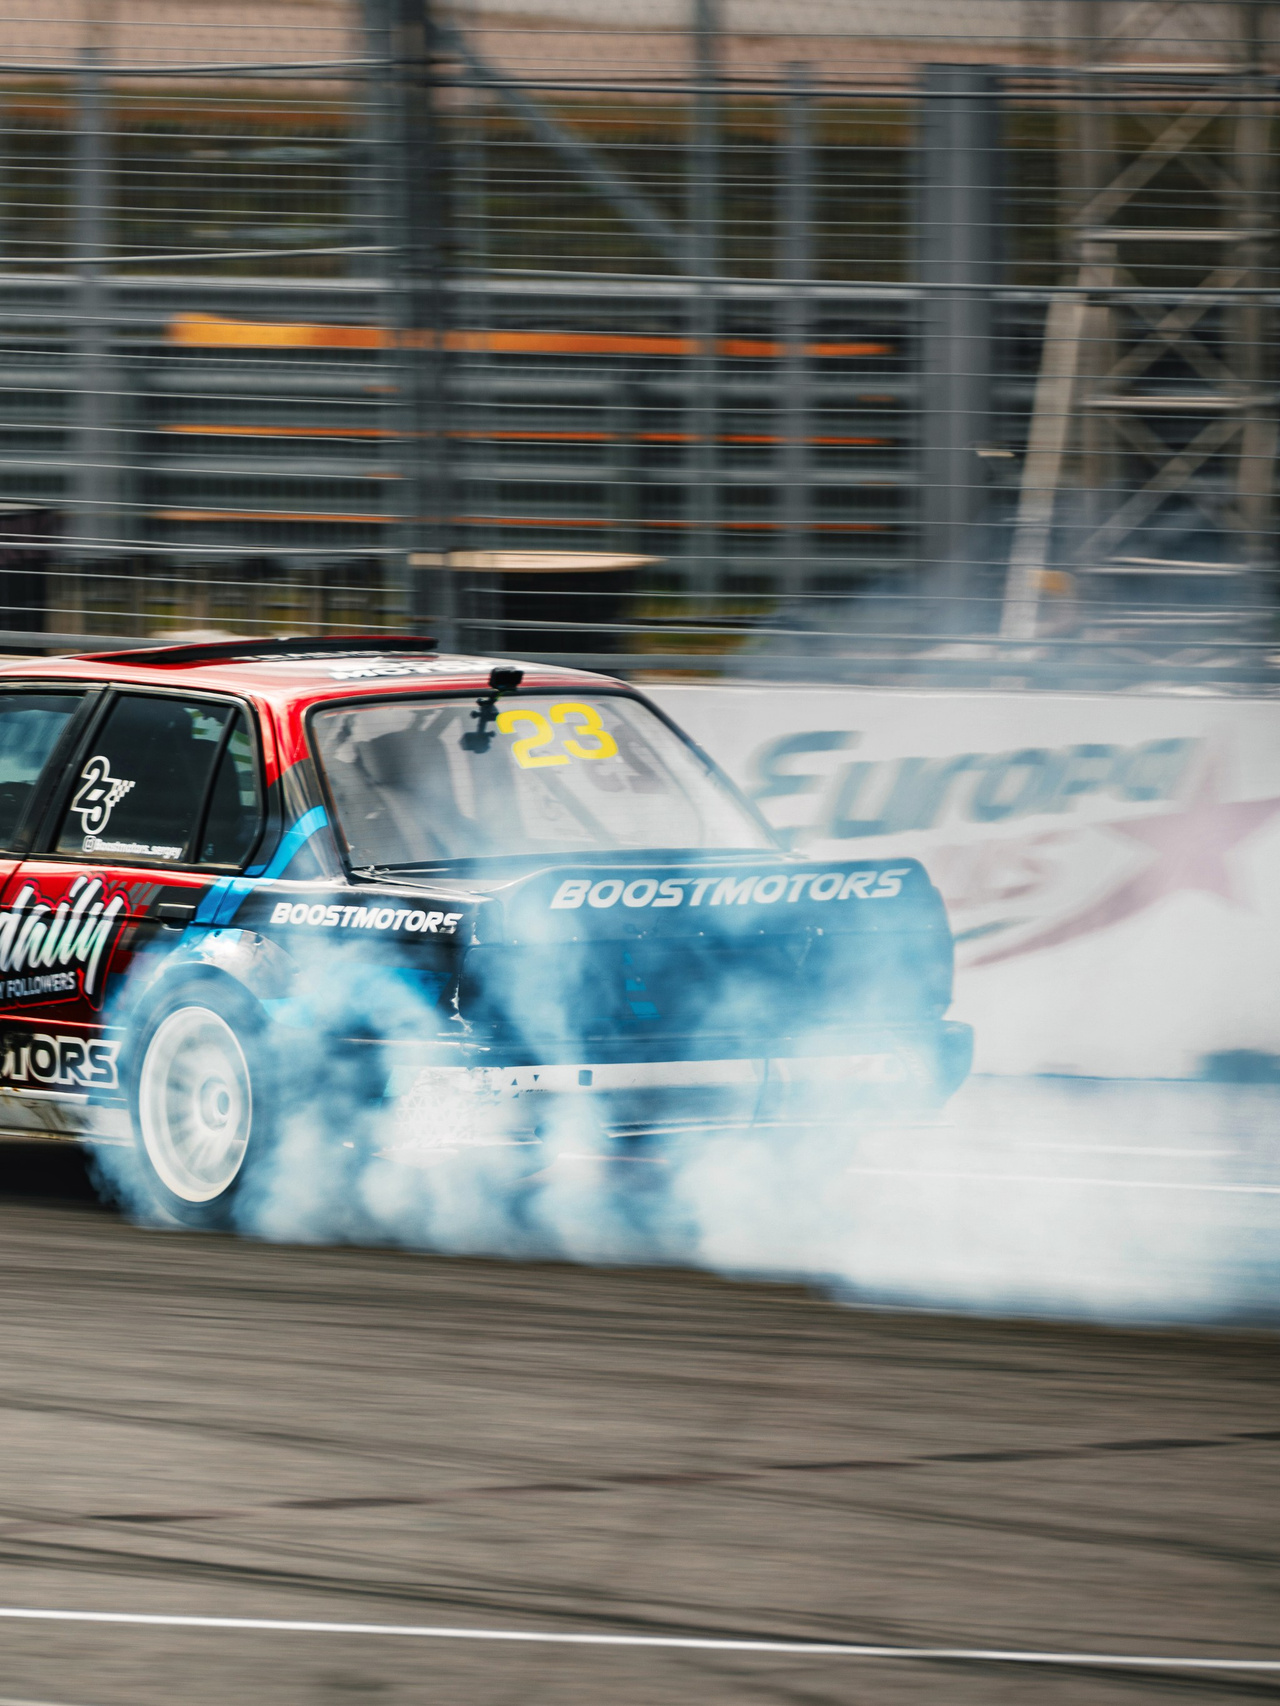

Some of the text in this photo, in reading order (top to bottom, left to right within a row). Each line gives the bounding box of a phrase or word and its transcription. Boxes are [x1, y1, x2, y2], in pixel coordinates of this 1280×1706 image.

[496, 702, 619, 769] 23
[550, 868, 911, 909] BOOSTMOTORS
[270, 902, 464, 935] BOOSTMOTORS
[6, 971, 76, 999] FOLLOWERS
